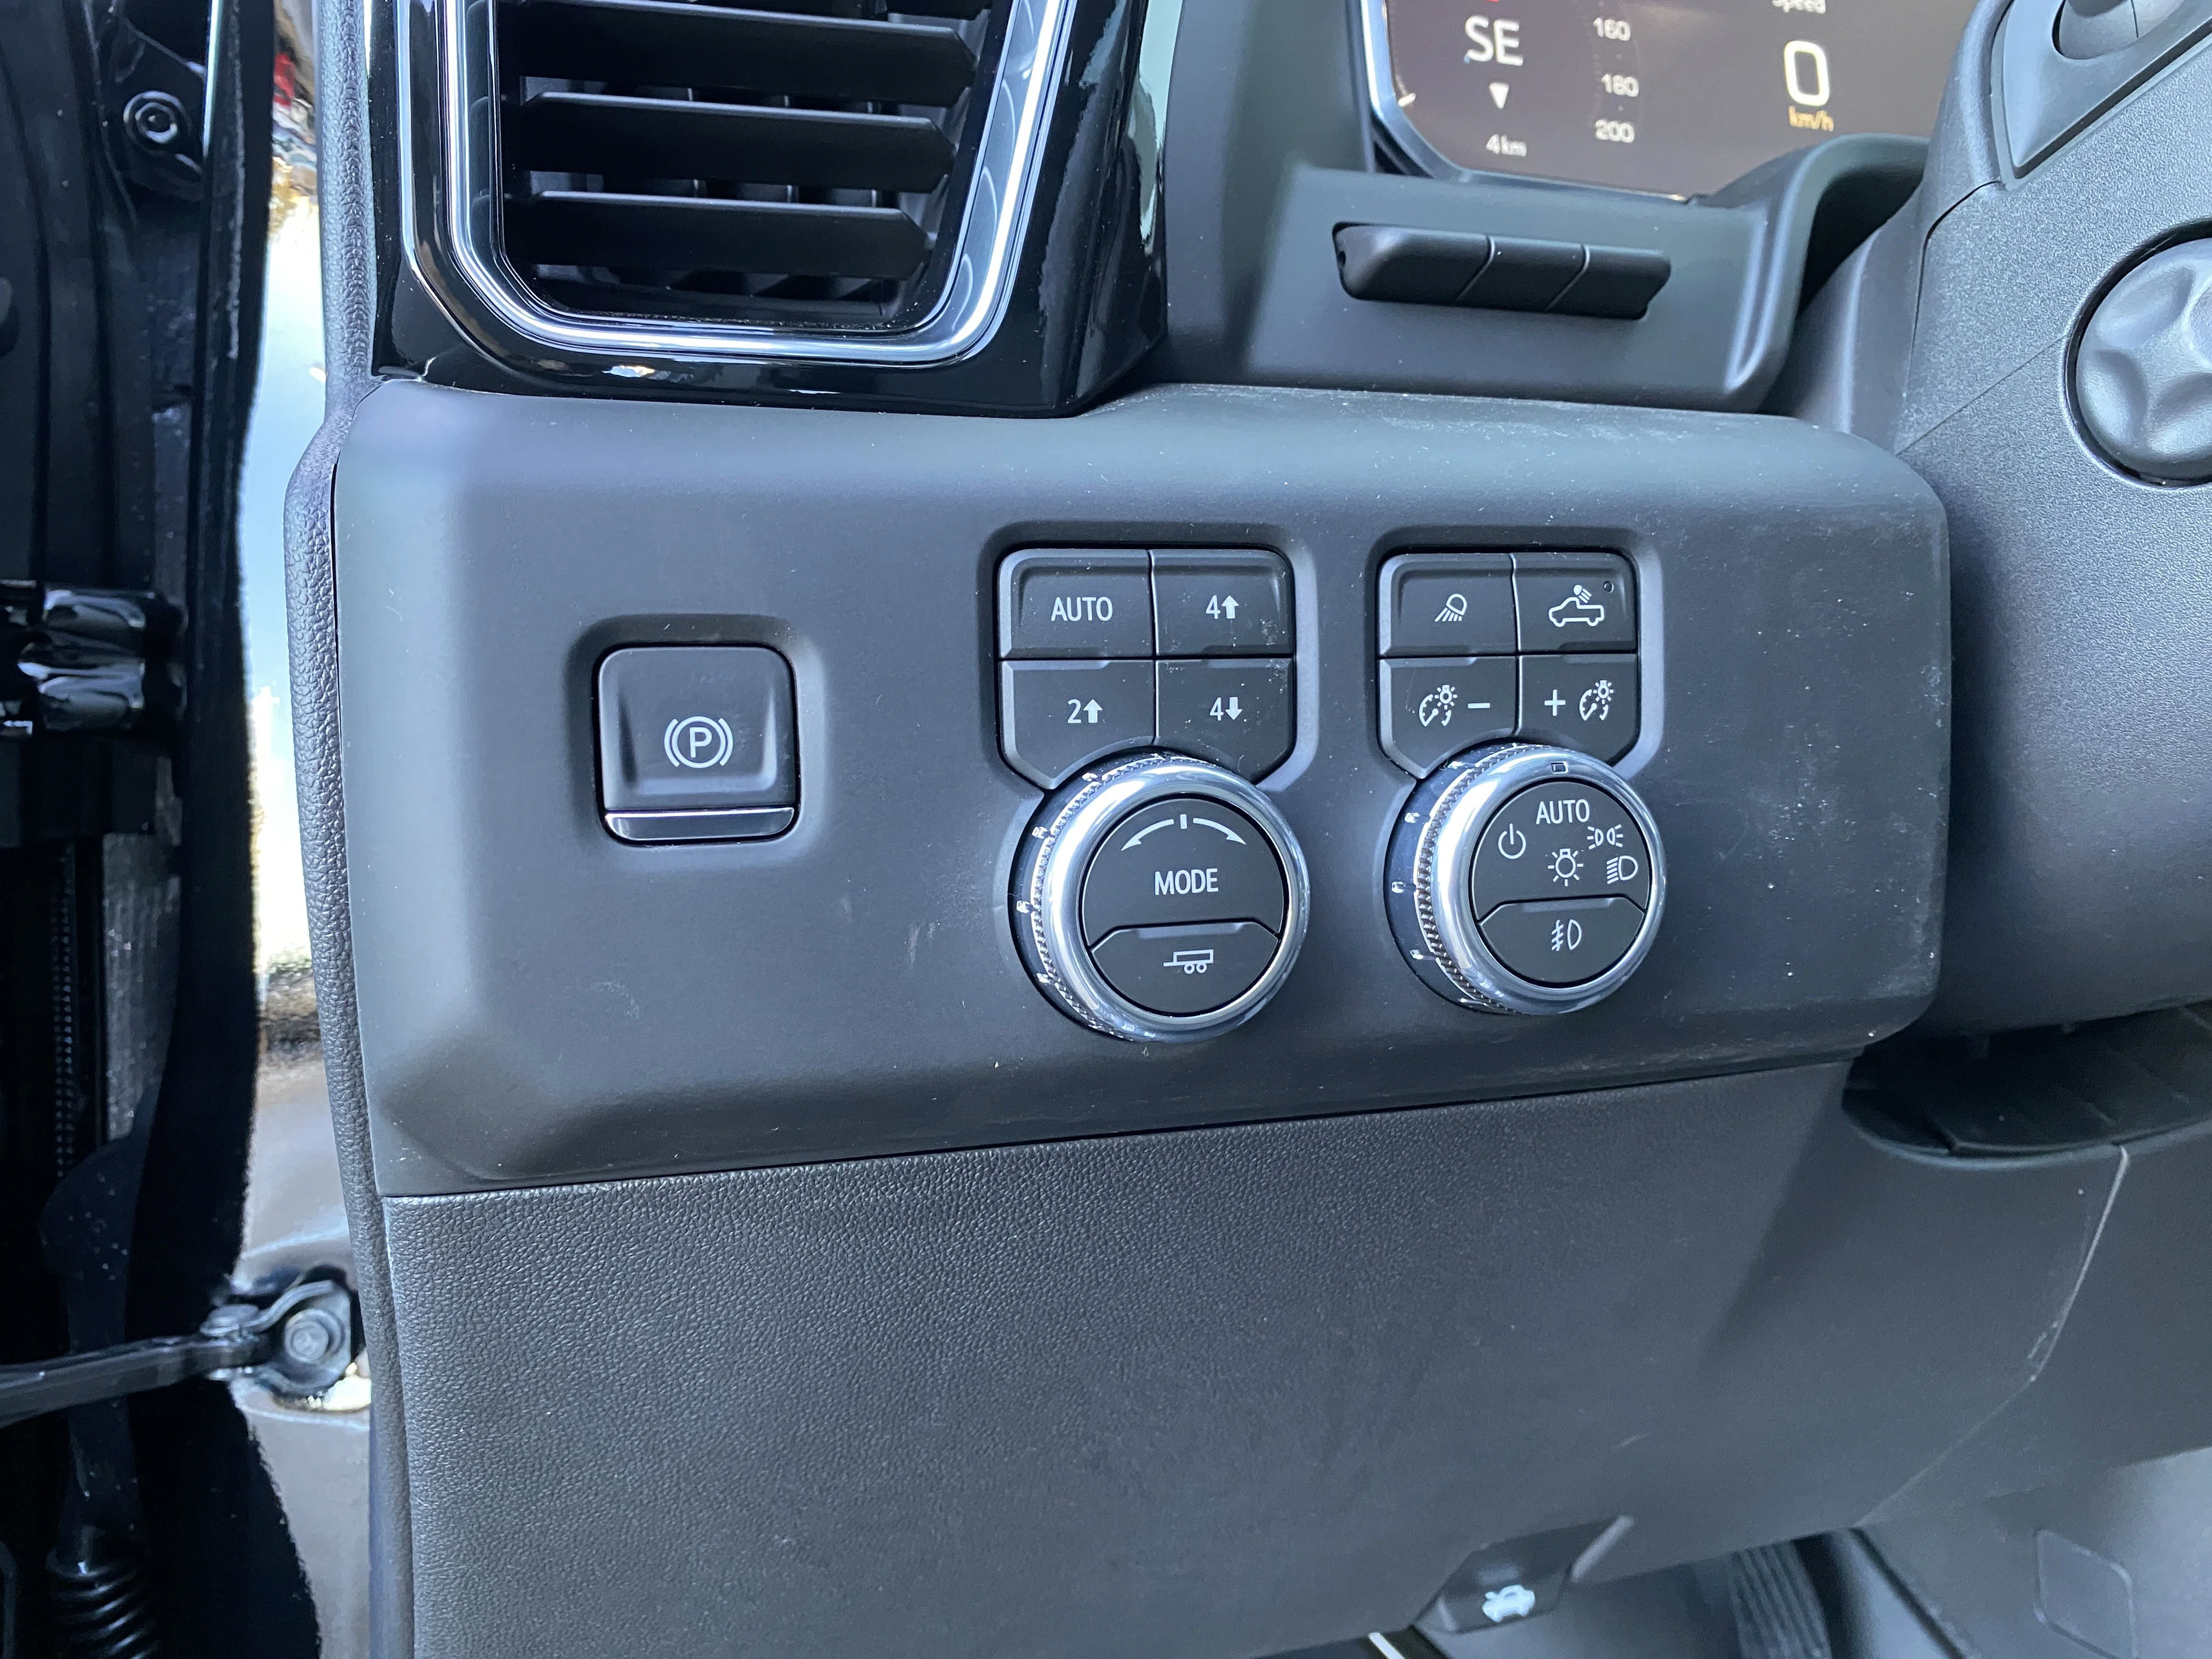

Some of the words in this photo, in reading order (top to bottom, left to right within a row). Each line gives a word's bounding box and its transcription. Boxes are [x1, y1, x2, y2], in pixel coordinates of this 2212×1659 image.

[1465, 15, 1523, 66] SE
[1593, 18, 1630, 41] 160
[1602, 74, 1639, 97] 180
[1784, 40, 1830, 106] 0
[1595, 120, 1635, 143] 200
[1788, 106, 1834, 132] km/h
[1051, 597, 1113, 622] AUTO
[1206, 595, 1221, 619] 4
[1068, 699, 1081, 724] 2
[1210, 697, 1224, 721] 4
[689, 727, 712, 758] P
[1536, 799, 1590, 824] AUTO
[1154, 868, 1218, 895] MODE
